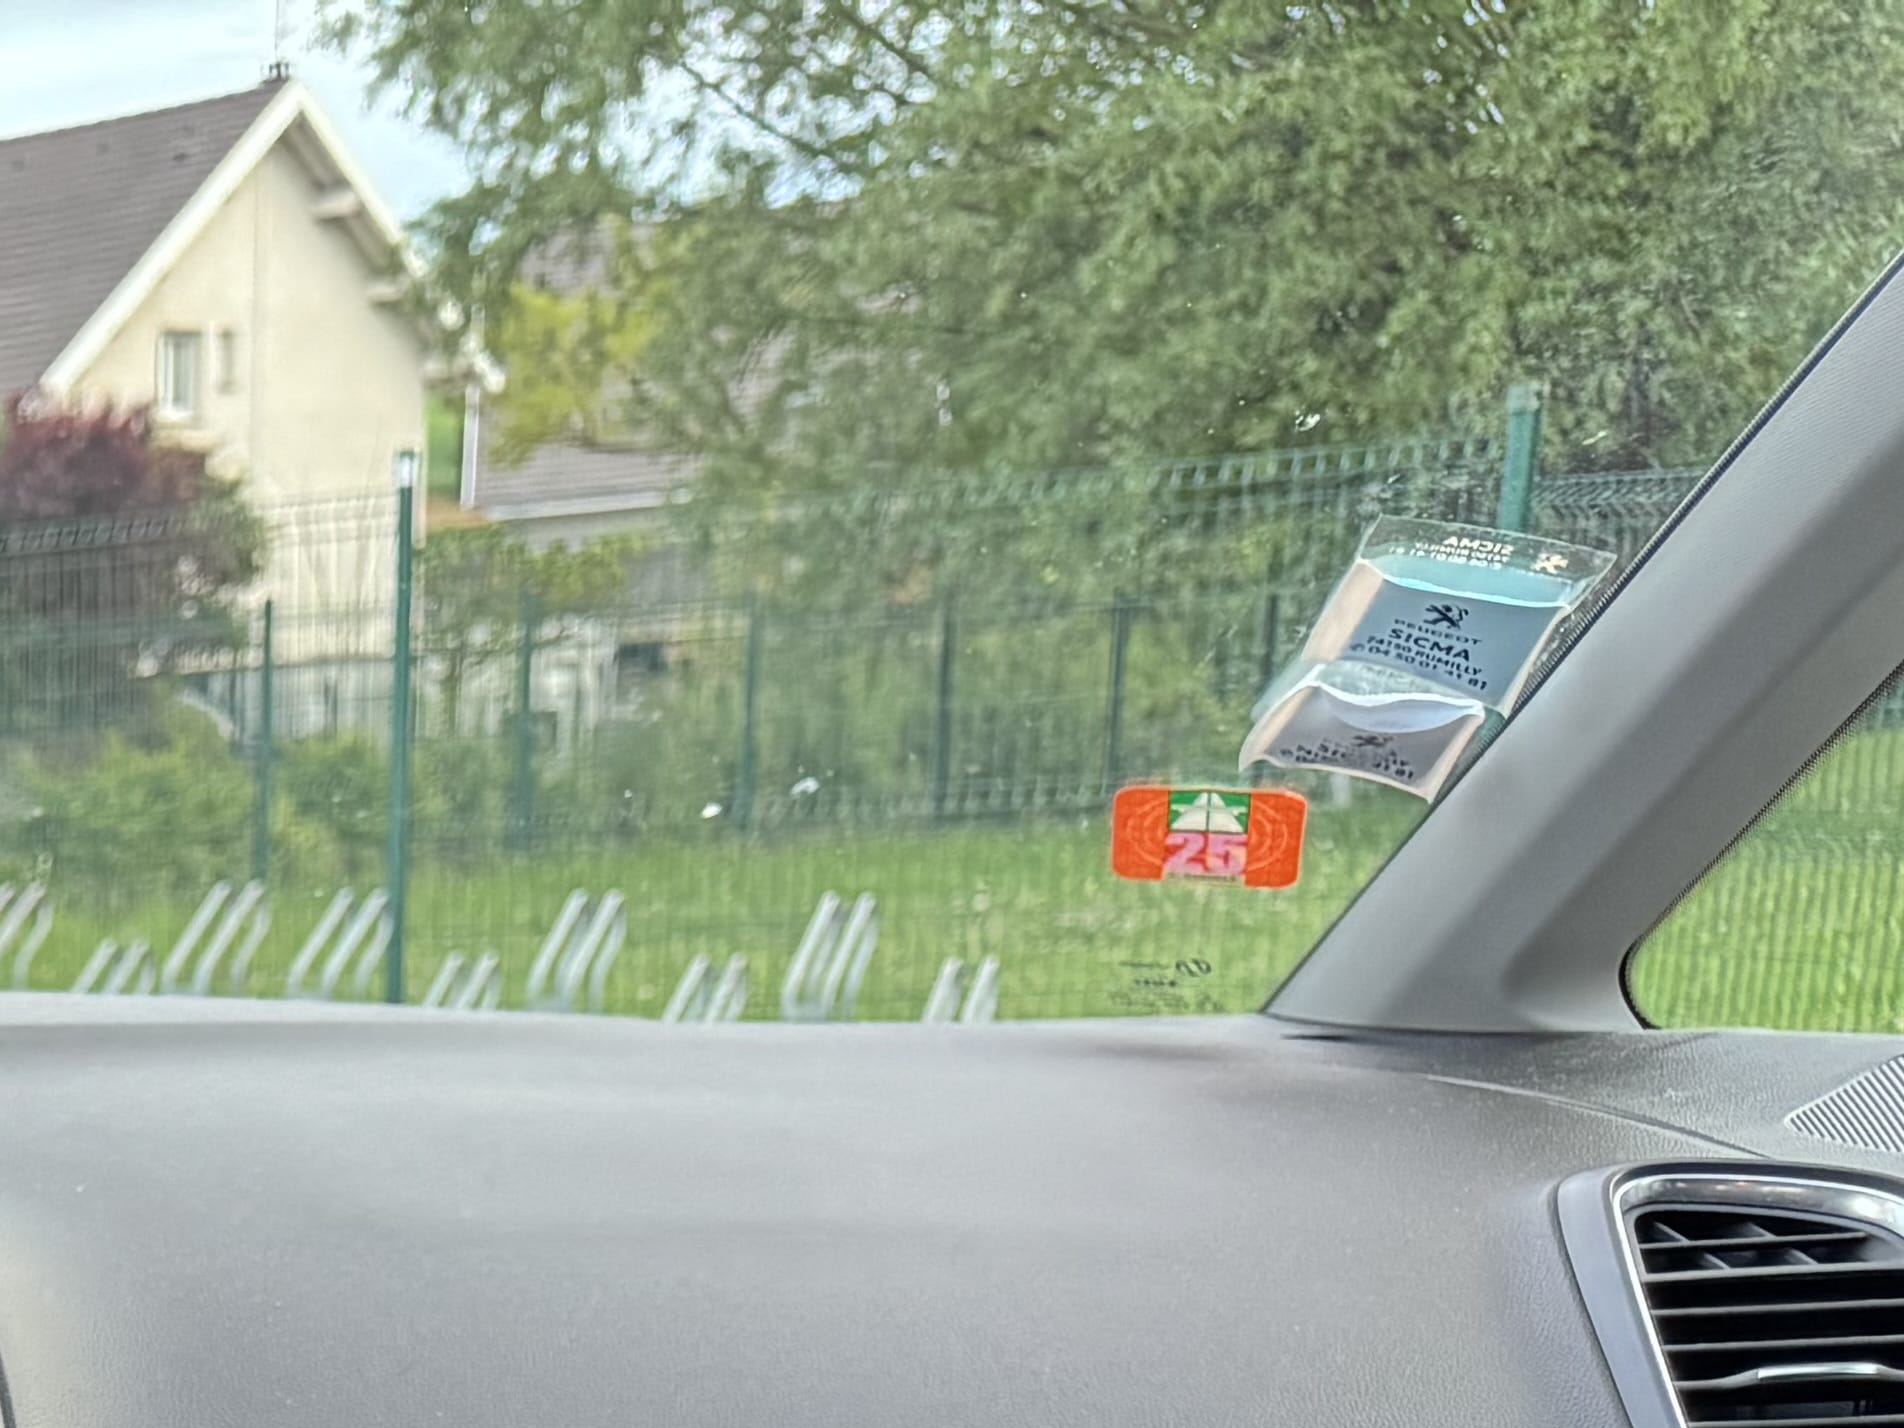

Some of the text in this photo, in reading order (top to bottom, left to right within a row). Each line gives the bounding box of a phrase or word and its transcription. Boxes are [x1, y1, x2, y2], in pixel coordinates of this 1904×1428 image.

[1389, 628, 1469, 661] SICMA
[1394, 619, 1482, 645] PEUGEOT
[1415, 650, 1482, 676] RUMILLY
[1164, 833, 1247, 874] 25
